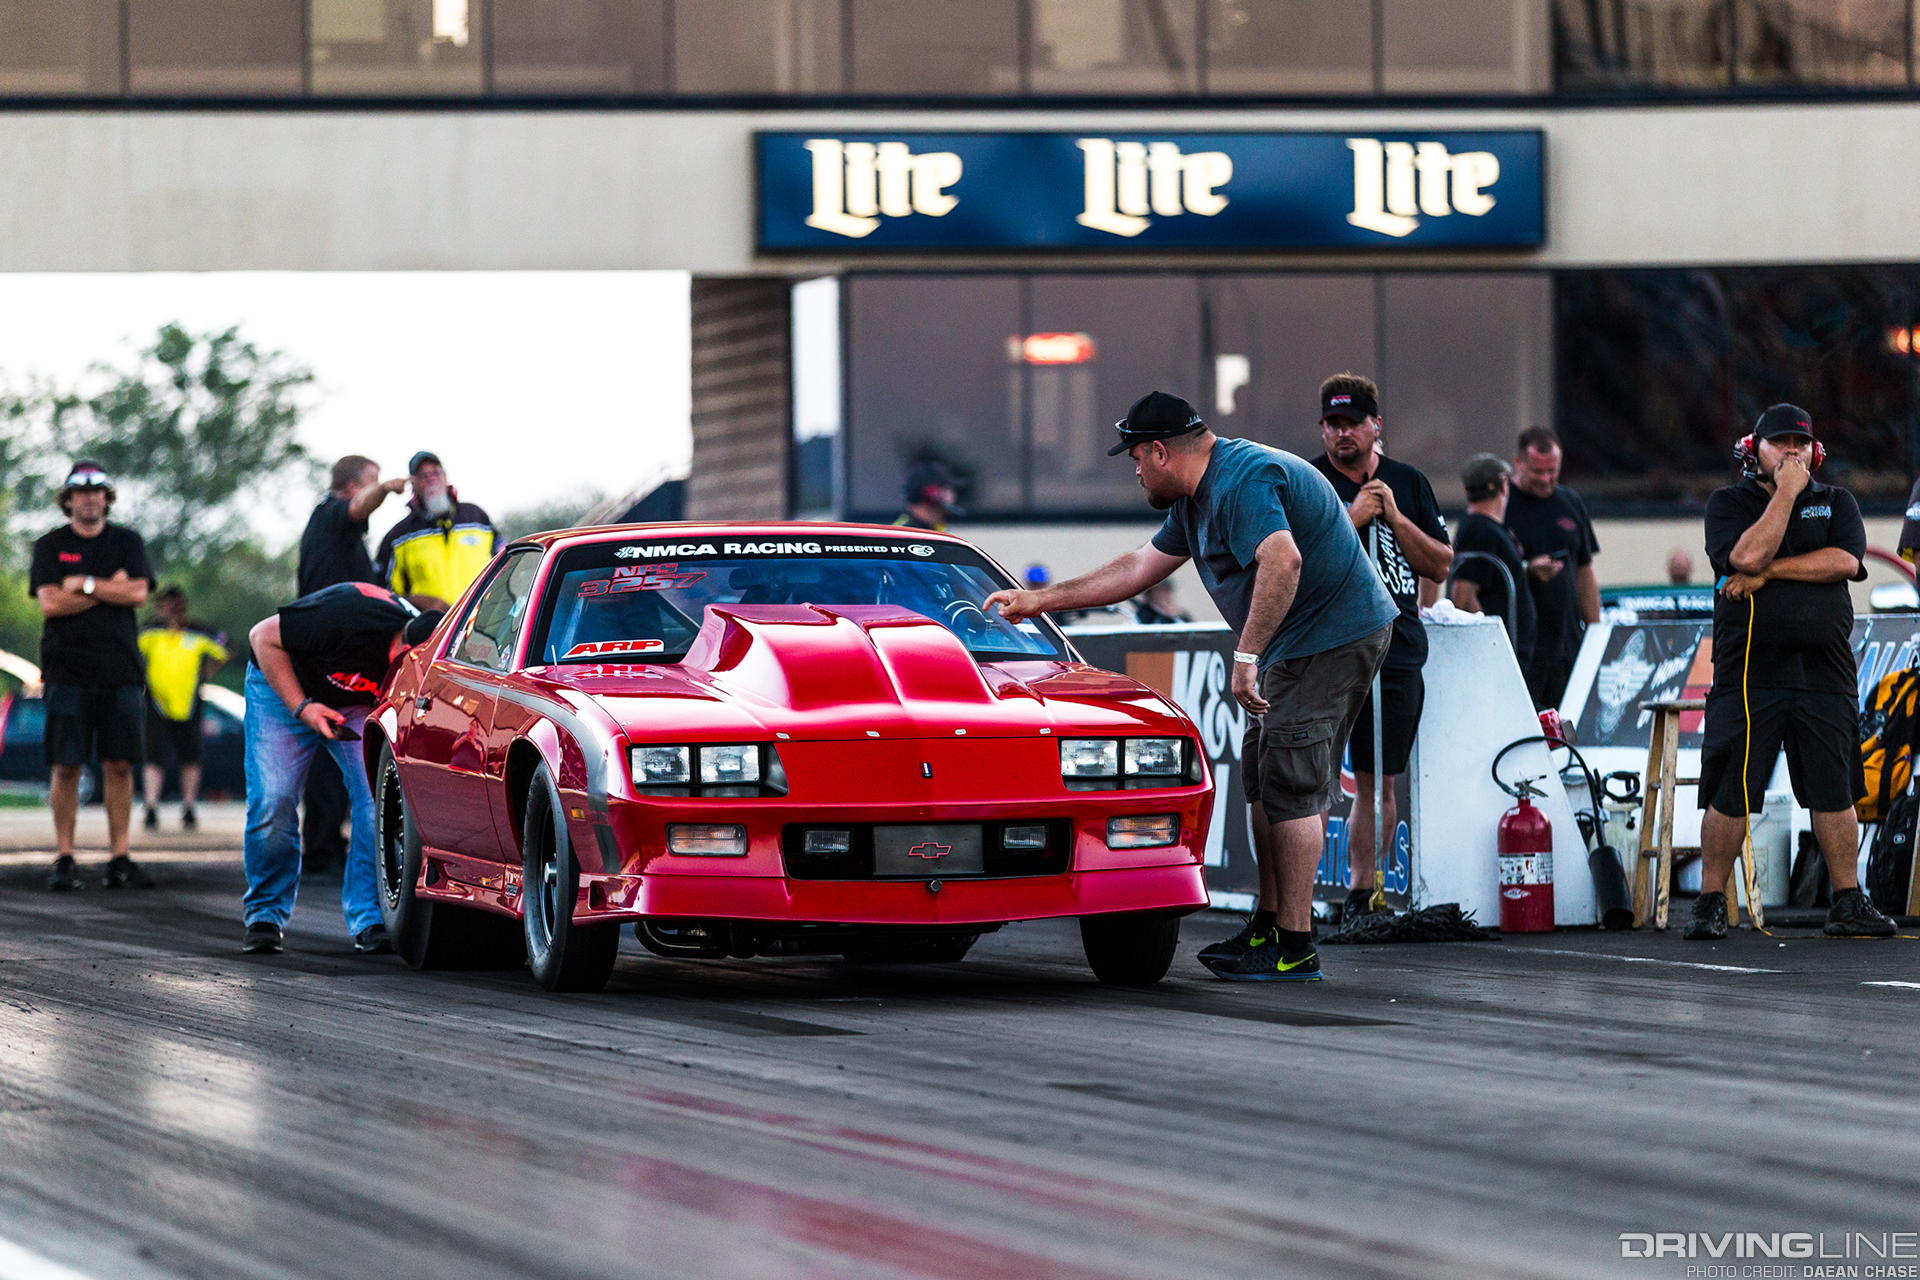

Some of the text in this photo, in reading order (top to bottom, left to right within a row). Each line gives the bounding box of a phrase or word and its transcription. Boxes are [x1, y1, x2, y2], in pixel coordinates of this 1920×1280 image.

[804, 137, 1501, 238] Lite Lite Lite
[632, 543, 718, 558] NMCA
[724, 542, 821, 554] RACING
[825, 545, 888, 553] PRESENTED
[612, 563, 678, 578] NPS
[578, 572, 707, 598] 3257
[567, 640, 663, 656] ARP
